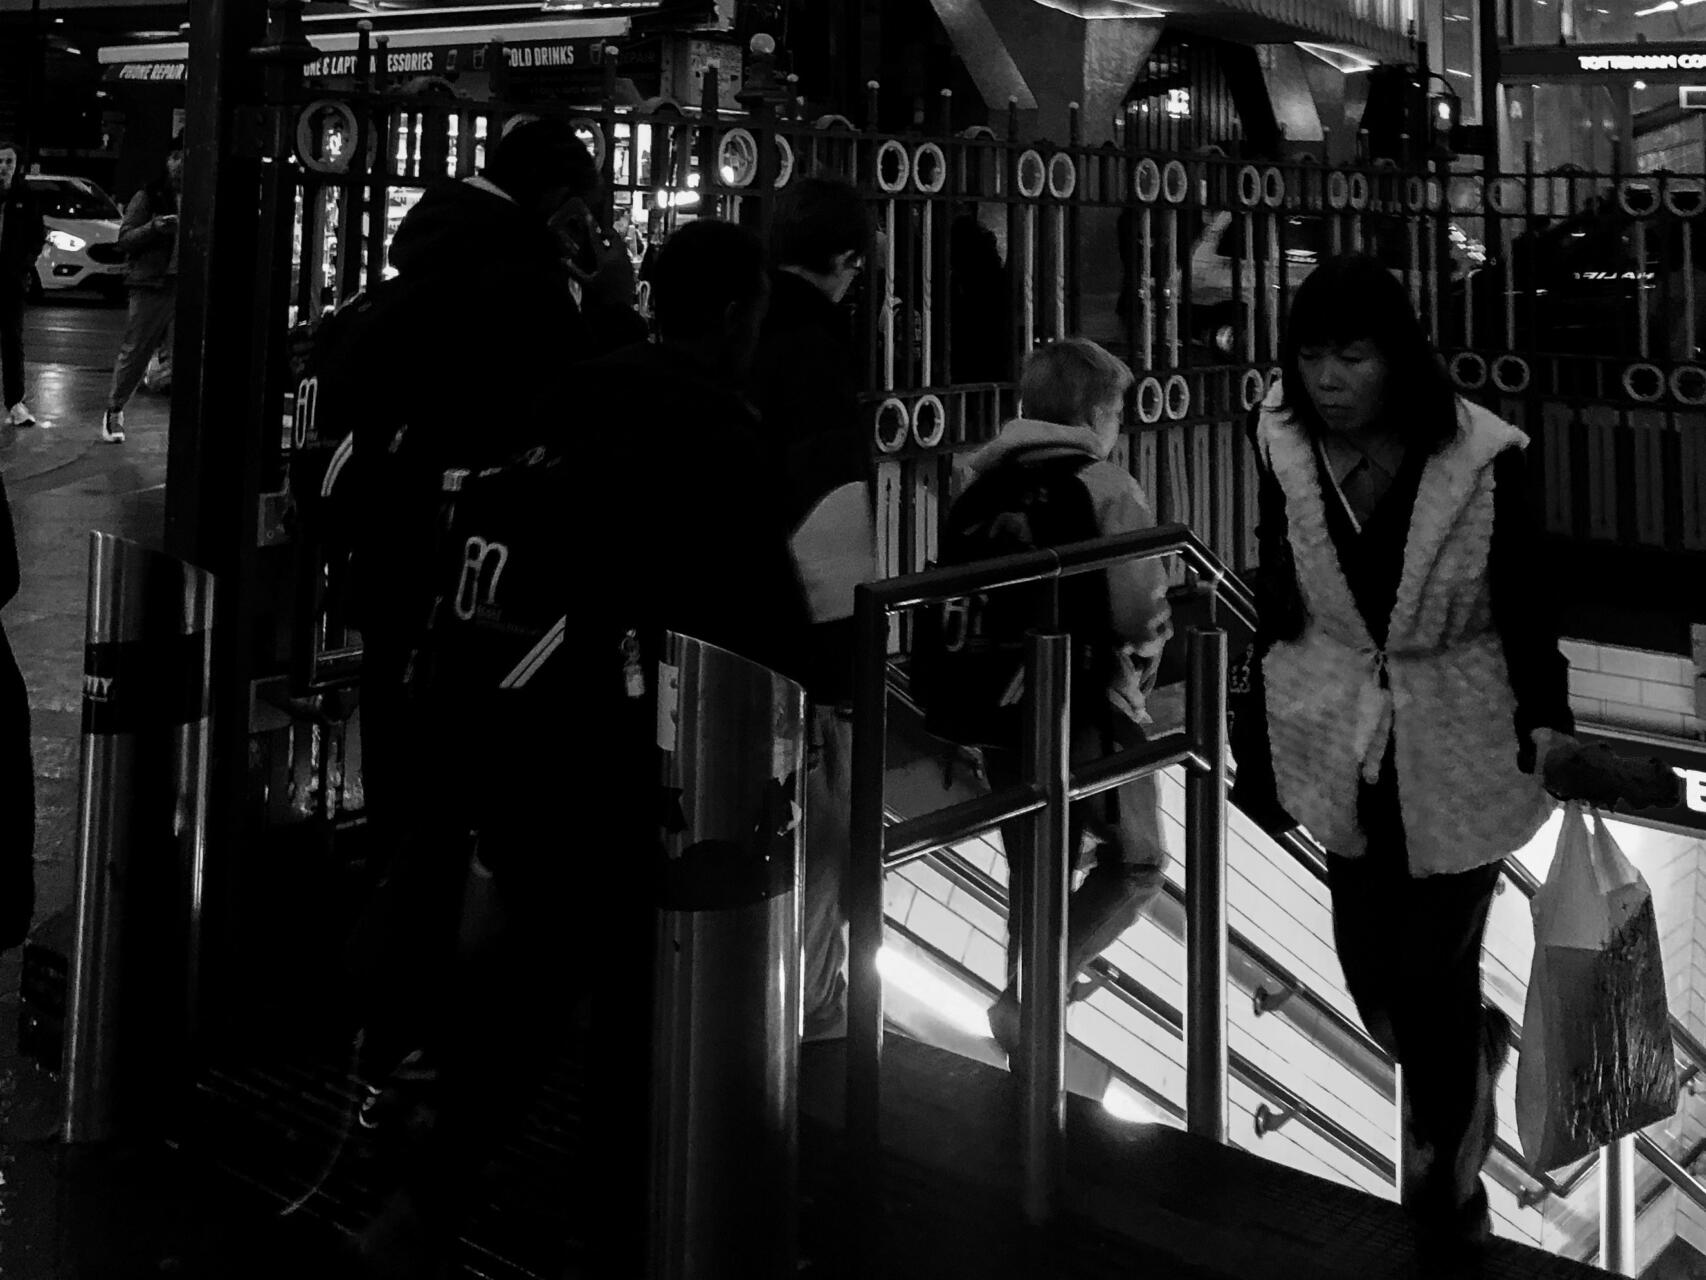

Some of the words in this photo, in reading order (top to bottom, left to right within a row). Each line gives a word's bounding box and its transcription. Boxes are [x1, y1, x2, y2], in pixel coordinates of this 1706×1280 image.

[321, 55, 331, 76] &
[330, 54, 360, 75] LAPT
[369, 51, 434, 74] AESSORIES
[533, 45, 575, 67] DRINKS
[1677, 53, 1706, 70] CO
[150, 62, 185, 80] REPAIR
